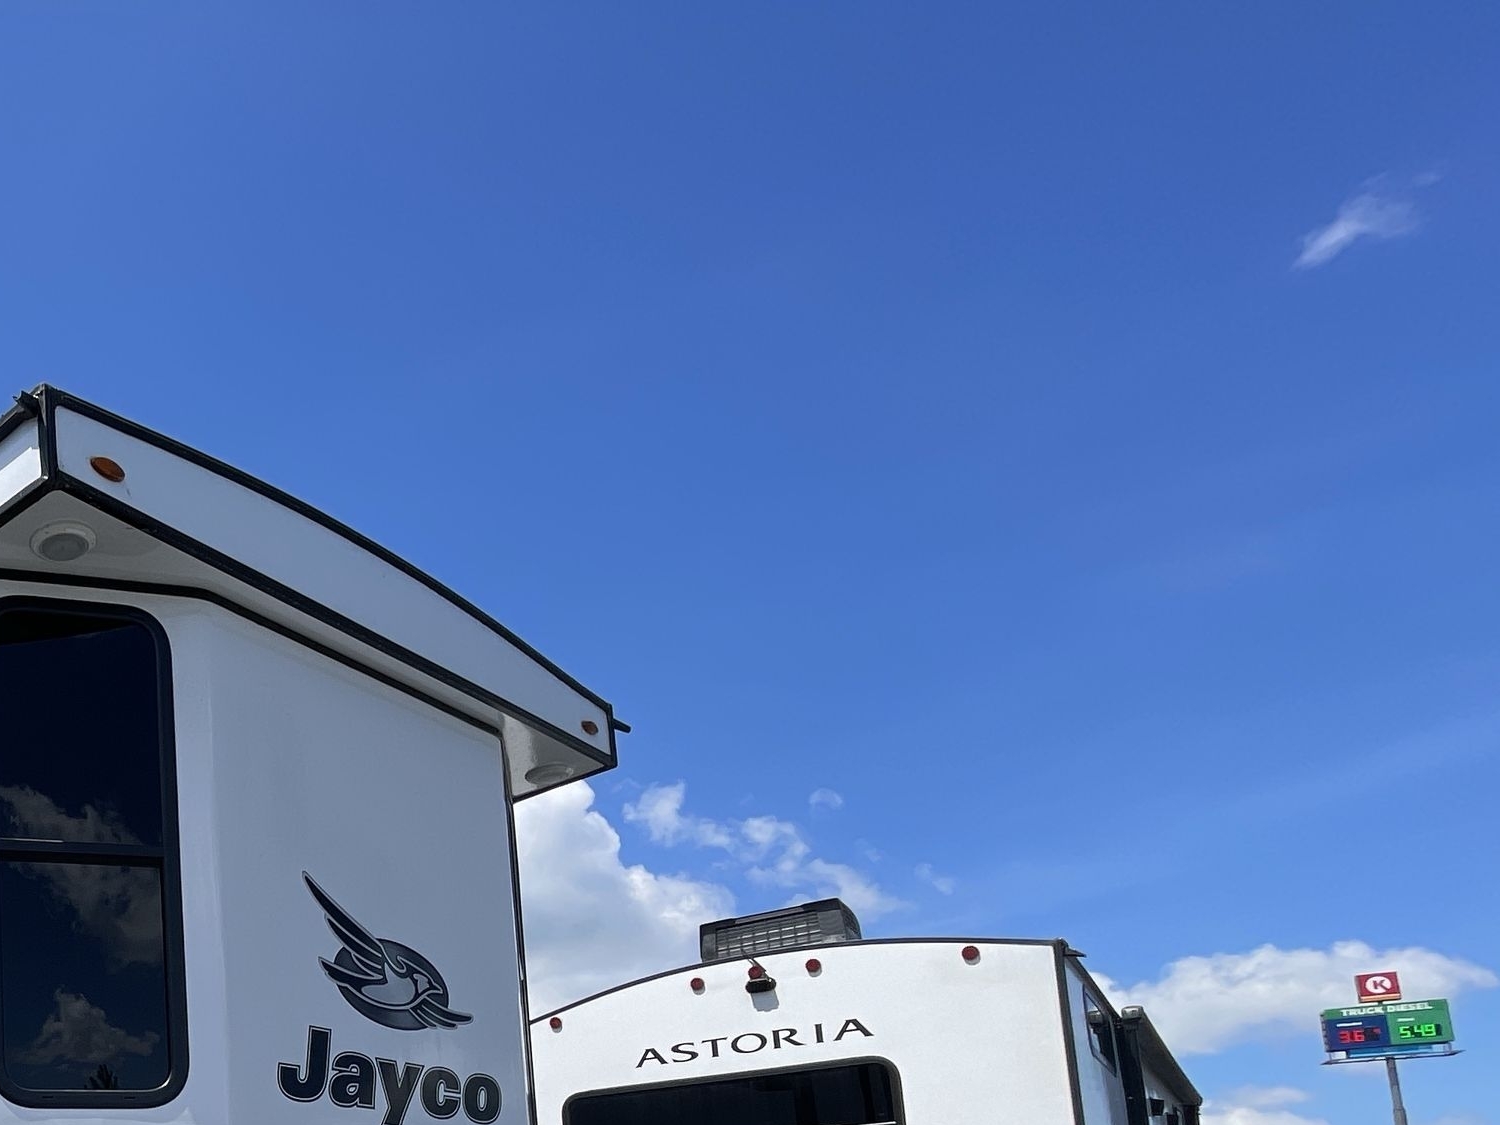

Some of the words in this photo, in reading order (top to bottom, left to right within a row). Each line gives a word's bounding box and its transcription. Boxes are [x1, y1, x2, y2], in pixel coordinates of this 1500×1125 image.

[1339, 1006, 1385, 1017] TRUCK
[1386, 1002, 1433, 1013] DIESEL
[1399, 1024, 1437, 1039] 5.49
[635, 1018, 875, 1069] ASTORIA
